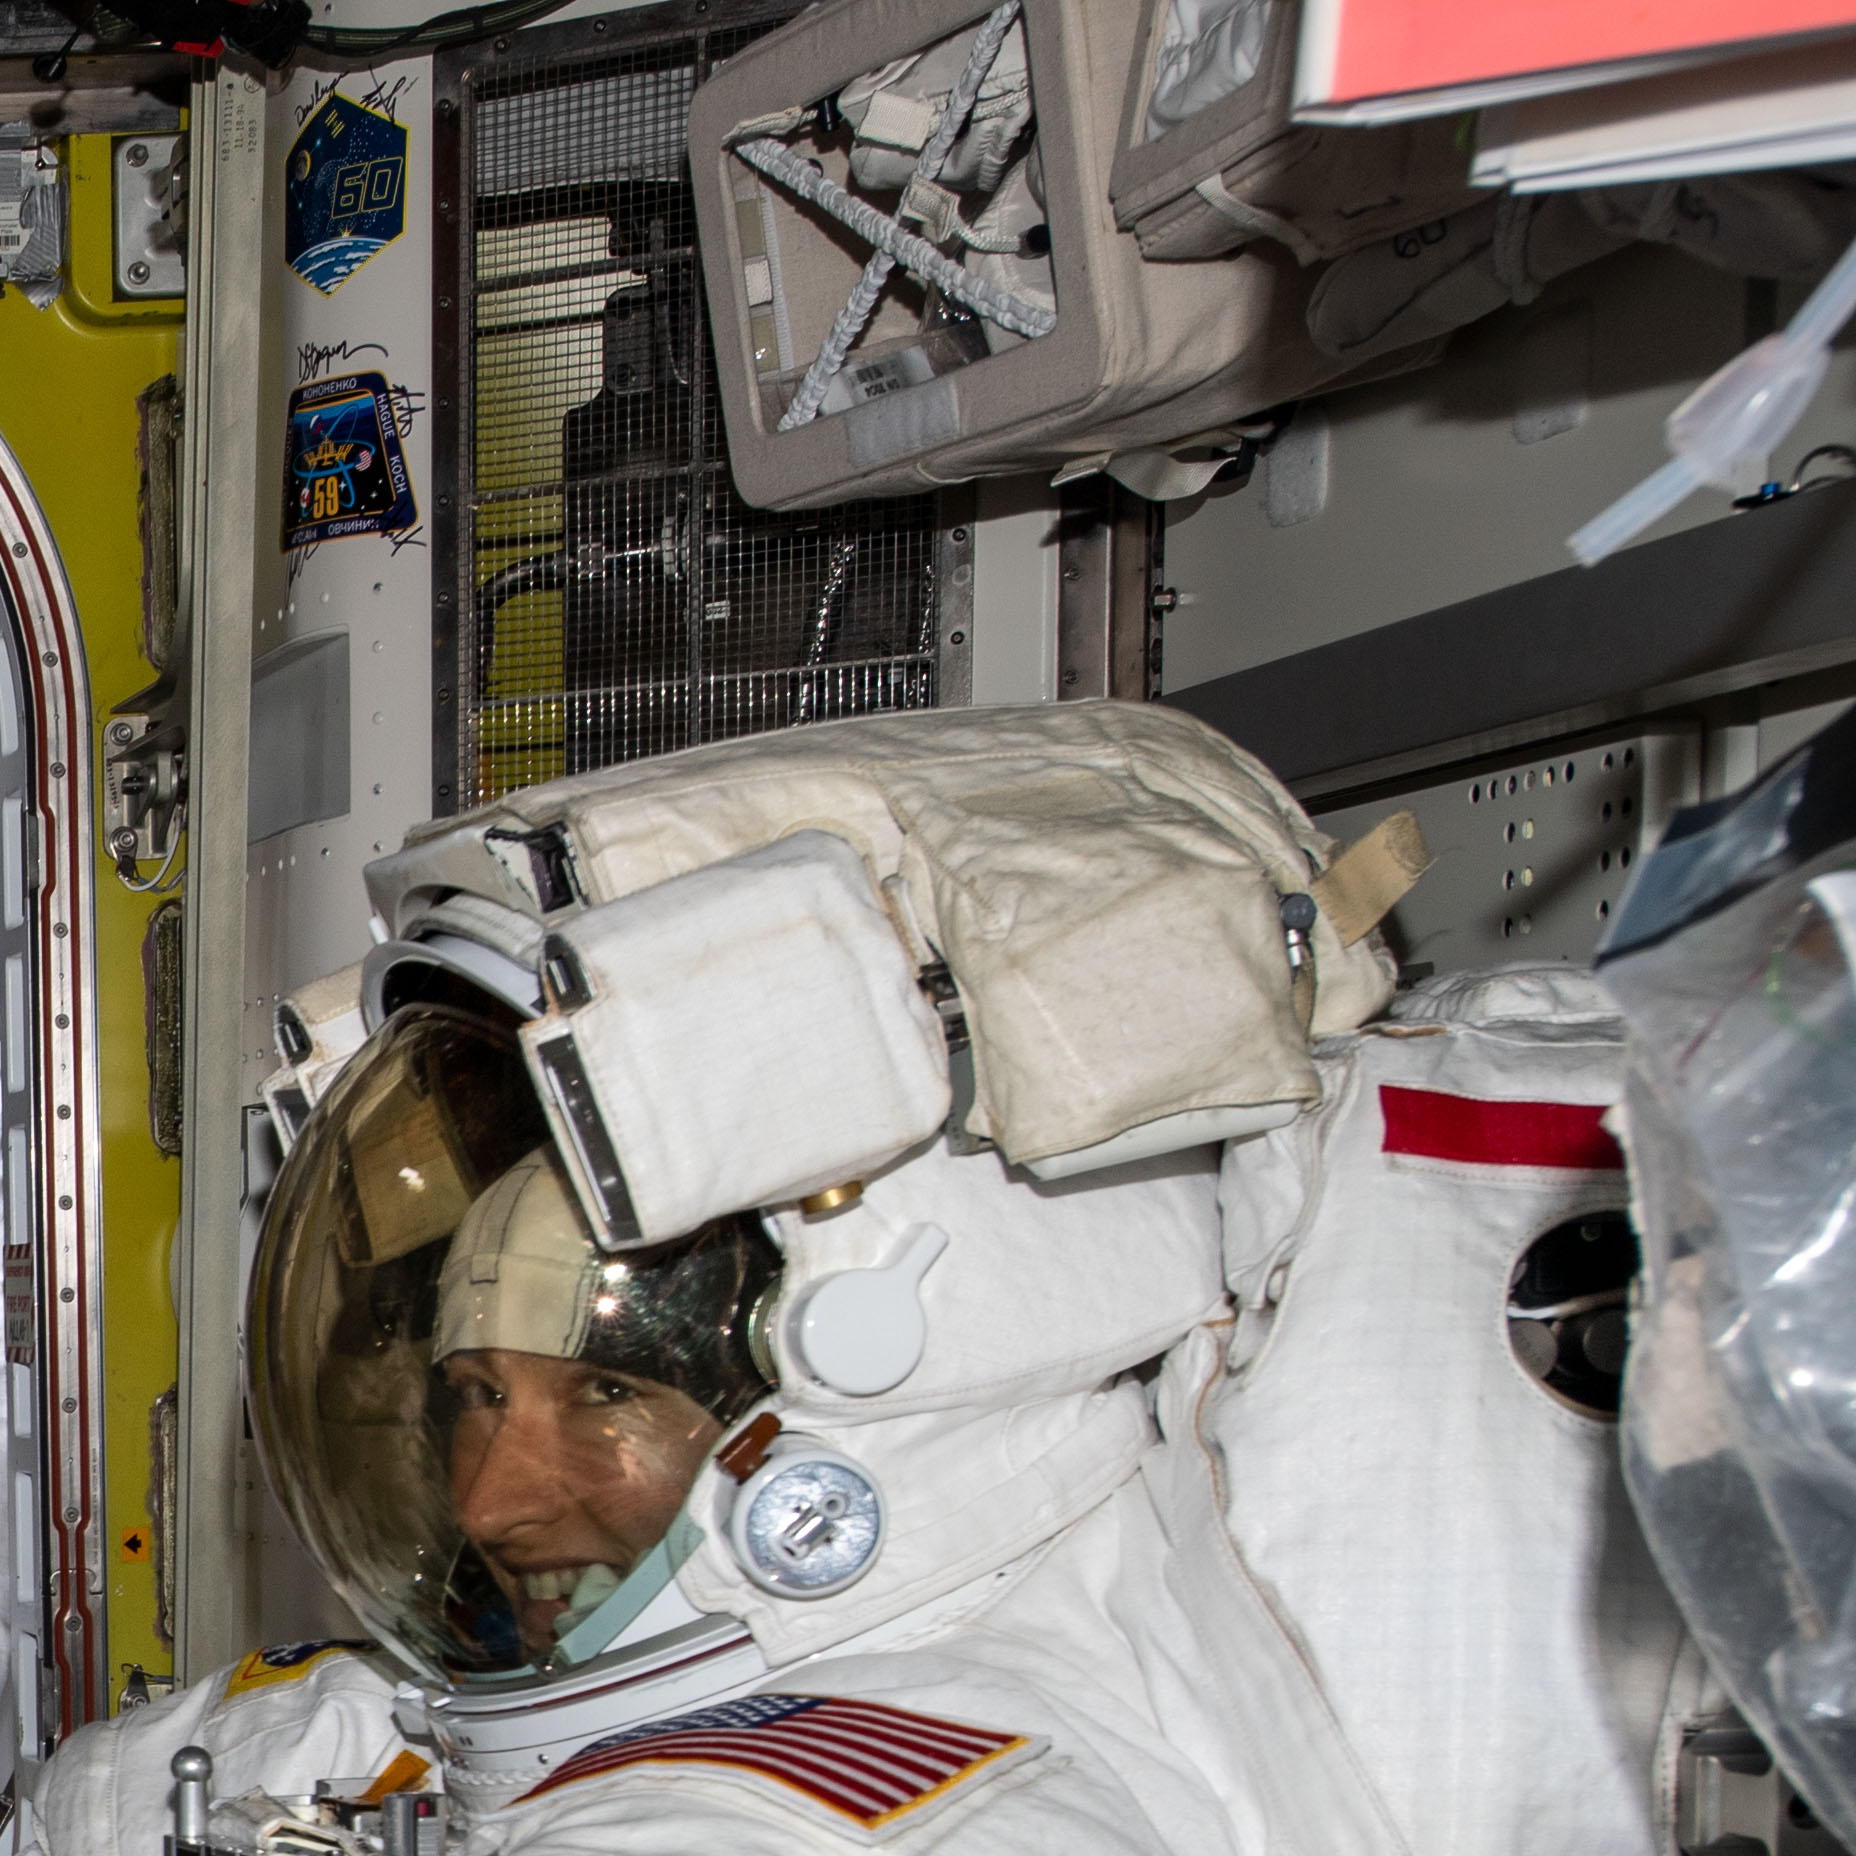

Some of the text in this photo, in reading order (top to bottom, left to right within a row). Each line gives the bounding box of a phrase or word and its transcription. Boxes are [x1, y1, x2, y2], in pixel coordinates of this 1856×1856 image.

[331, 156, 404, 219] 60
[376, 392, 396, 440] HAGUE
[312, 475, 340, 519] 59
[388, 454, 409, 494] KOCH
